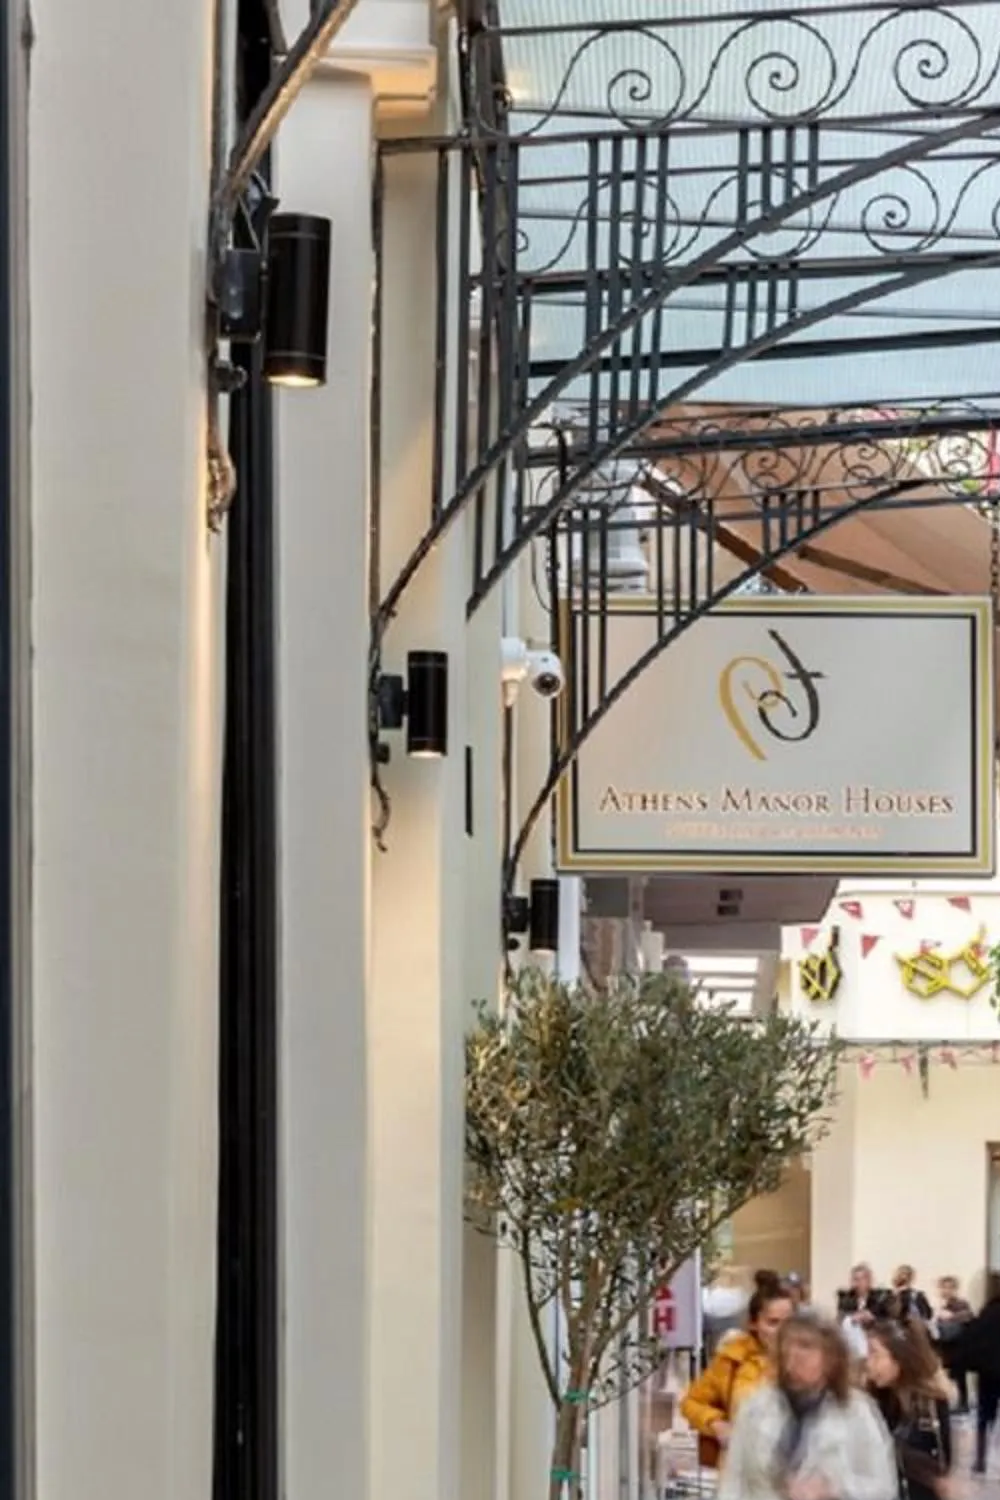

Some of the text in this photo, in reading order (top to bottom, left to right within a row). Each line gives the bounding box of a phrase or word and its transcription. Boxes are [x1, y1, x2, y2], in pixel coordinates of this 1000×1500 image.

[599, 785, 955, 814] ATHENS MANOR HOUSES
